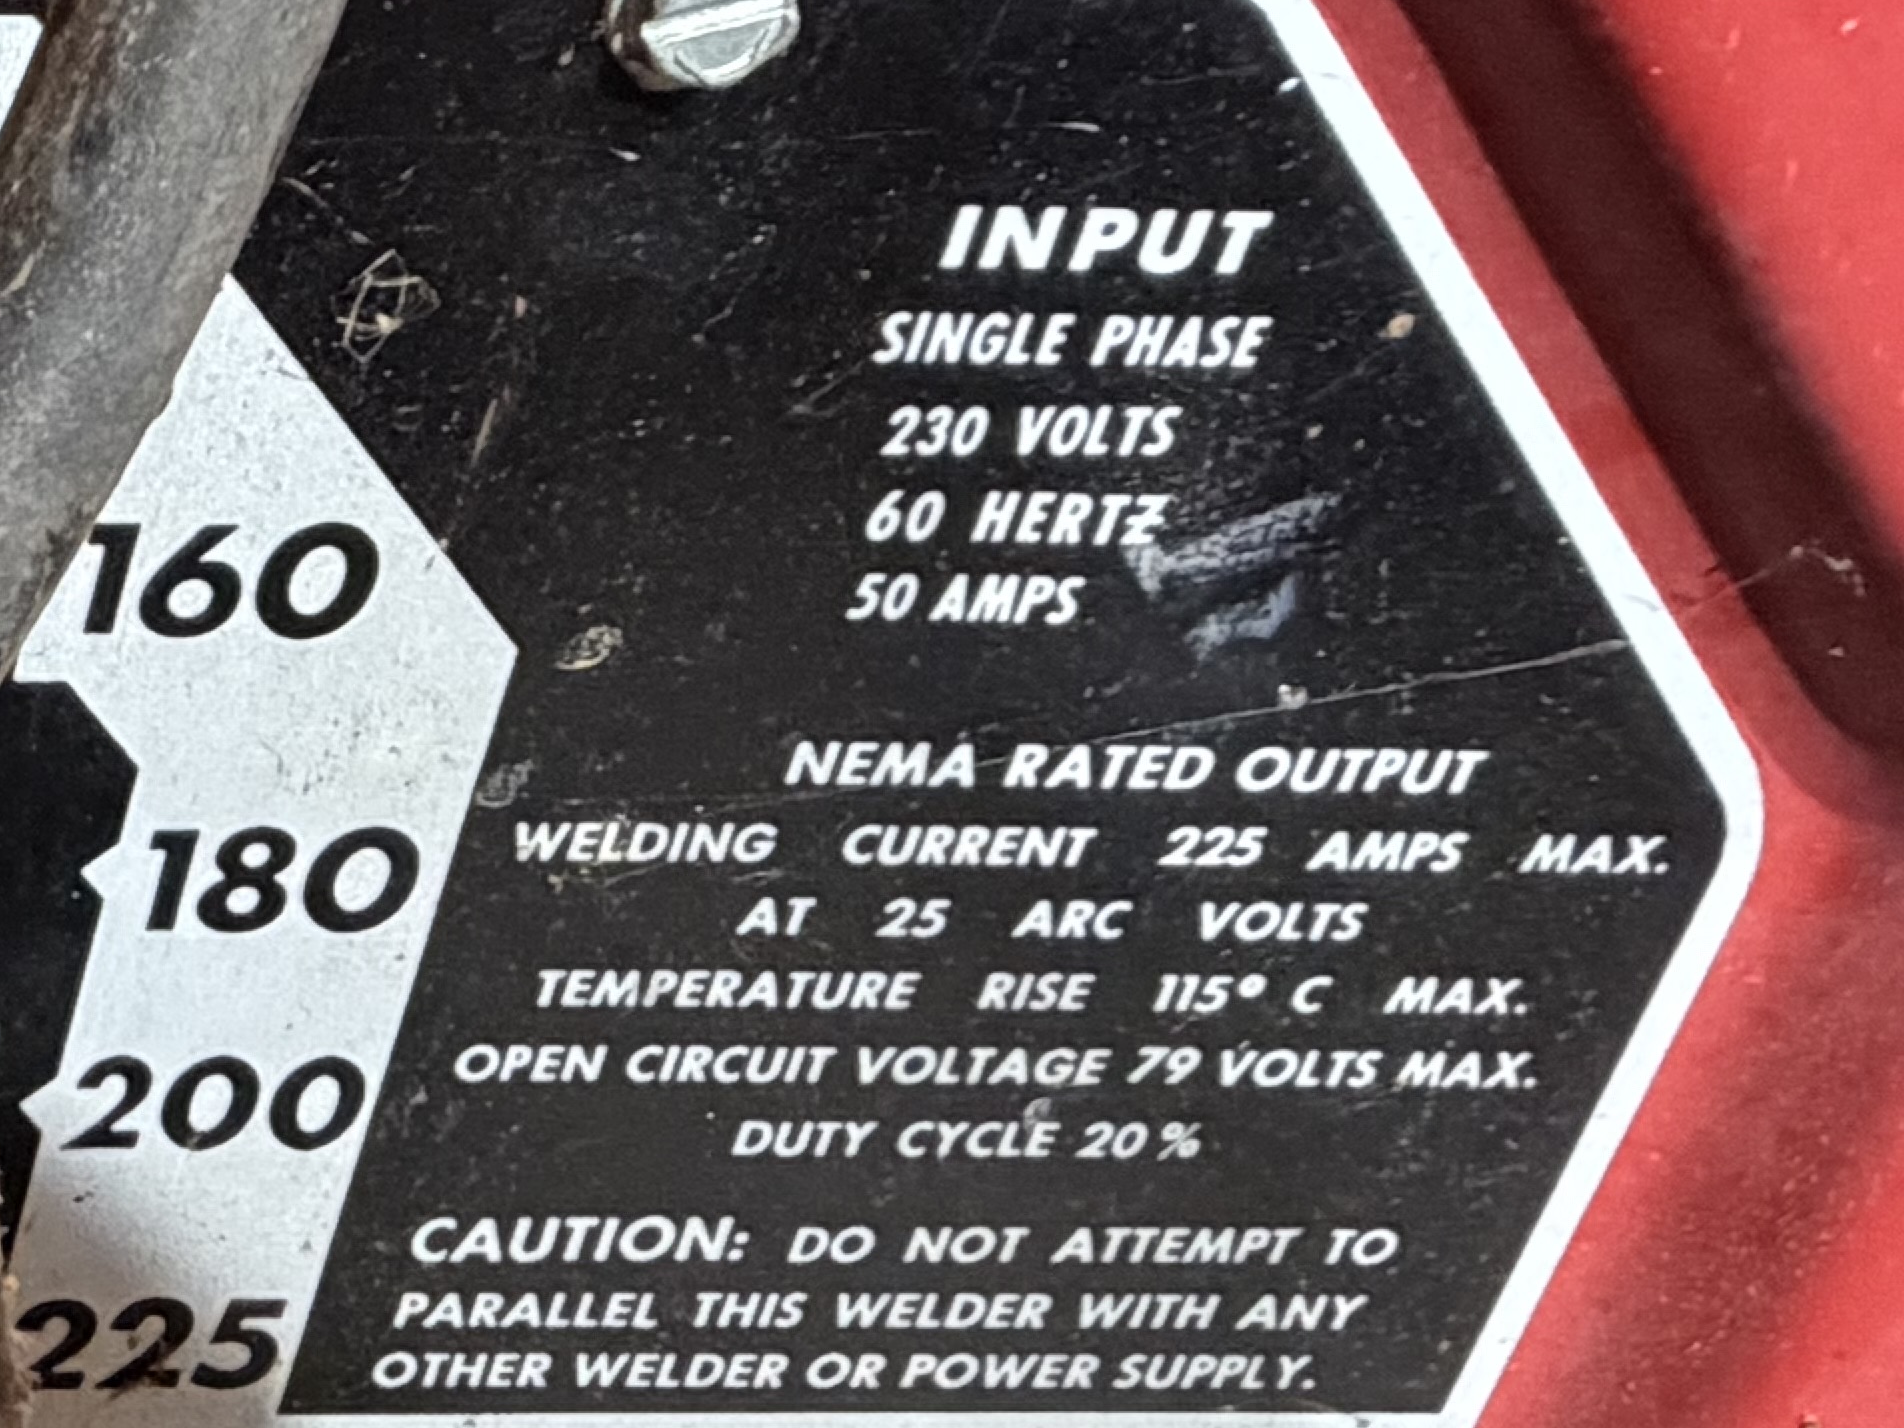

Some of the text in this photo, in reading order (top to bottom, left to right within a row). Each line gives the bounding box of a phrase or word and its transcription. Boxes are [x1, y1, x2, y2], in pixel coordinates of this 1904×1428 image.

[940, 205, 1274, 275] INPUT
[873, 311, 1273, 368] SINGLE PHASE
[881, 405, 1182, 456] 230 VOLTS
[866, 487, 1172, 547] 60 HERTZ
[84, 523, 380, 639] 160
[846, 573, 1086, 625] 50 AMPS
[785, 741, 1489, 795] NEMA RATED OUTPUT
[516, 821, 1668, 874] WELDING CURRENT 225 AMPS MAX.
[146, 826, 419, 933] 180
[736, 897, 1368, 941] AT 25 ARC VOLTS
[537, 970, 921, 1009] TEMPERATURE
[978, 972, 1095, 1010] RISE
[1291, 976, 1333, 1014] C
[1383, 977, 1526, 1015] MAX.
[455, 1044, 1536, 1088] OPEN CIRCUIT VOLTAGE 79 VOLTS MAX.
[59, 1055, 366, 1150] 200
[732, 1121, 877, 1157] DUTY
[898, 1118, 1060, 1158] CYCLE
[411, 1216, 1398, 1265] CAUTION: DO NOT ATTEMPT TO
[394, 1292, 1367, 1330] PARALLEL THIS WELDER WITH ANY
[10, 1297, 290, 1394] 225
[372, 1352, 1314, 1389] OTHER WELDER OR POWER SUPPLY.
